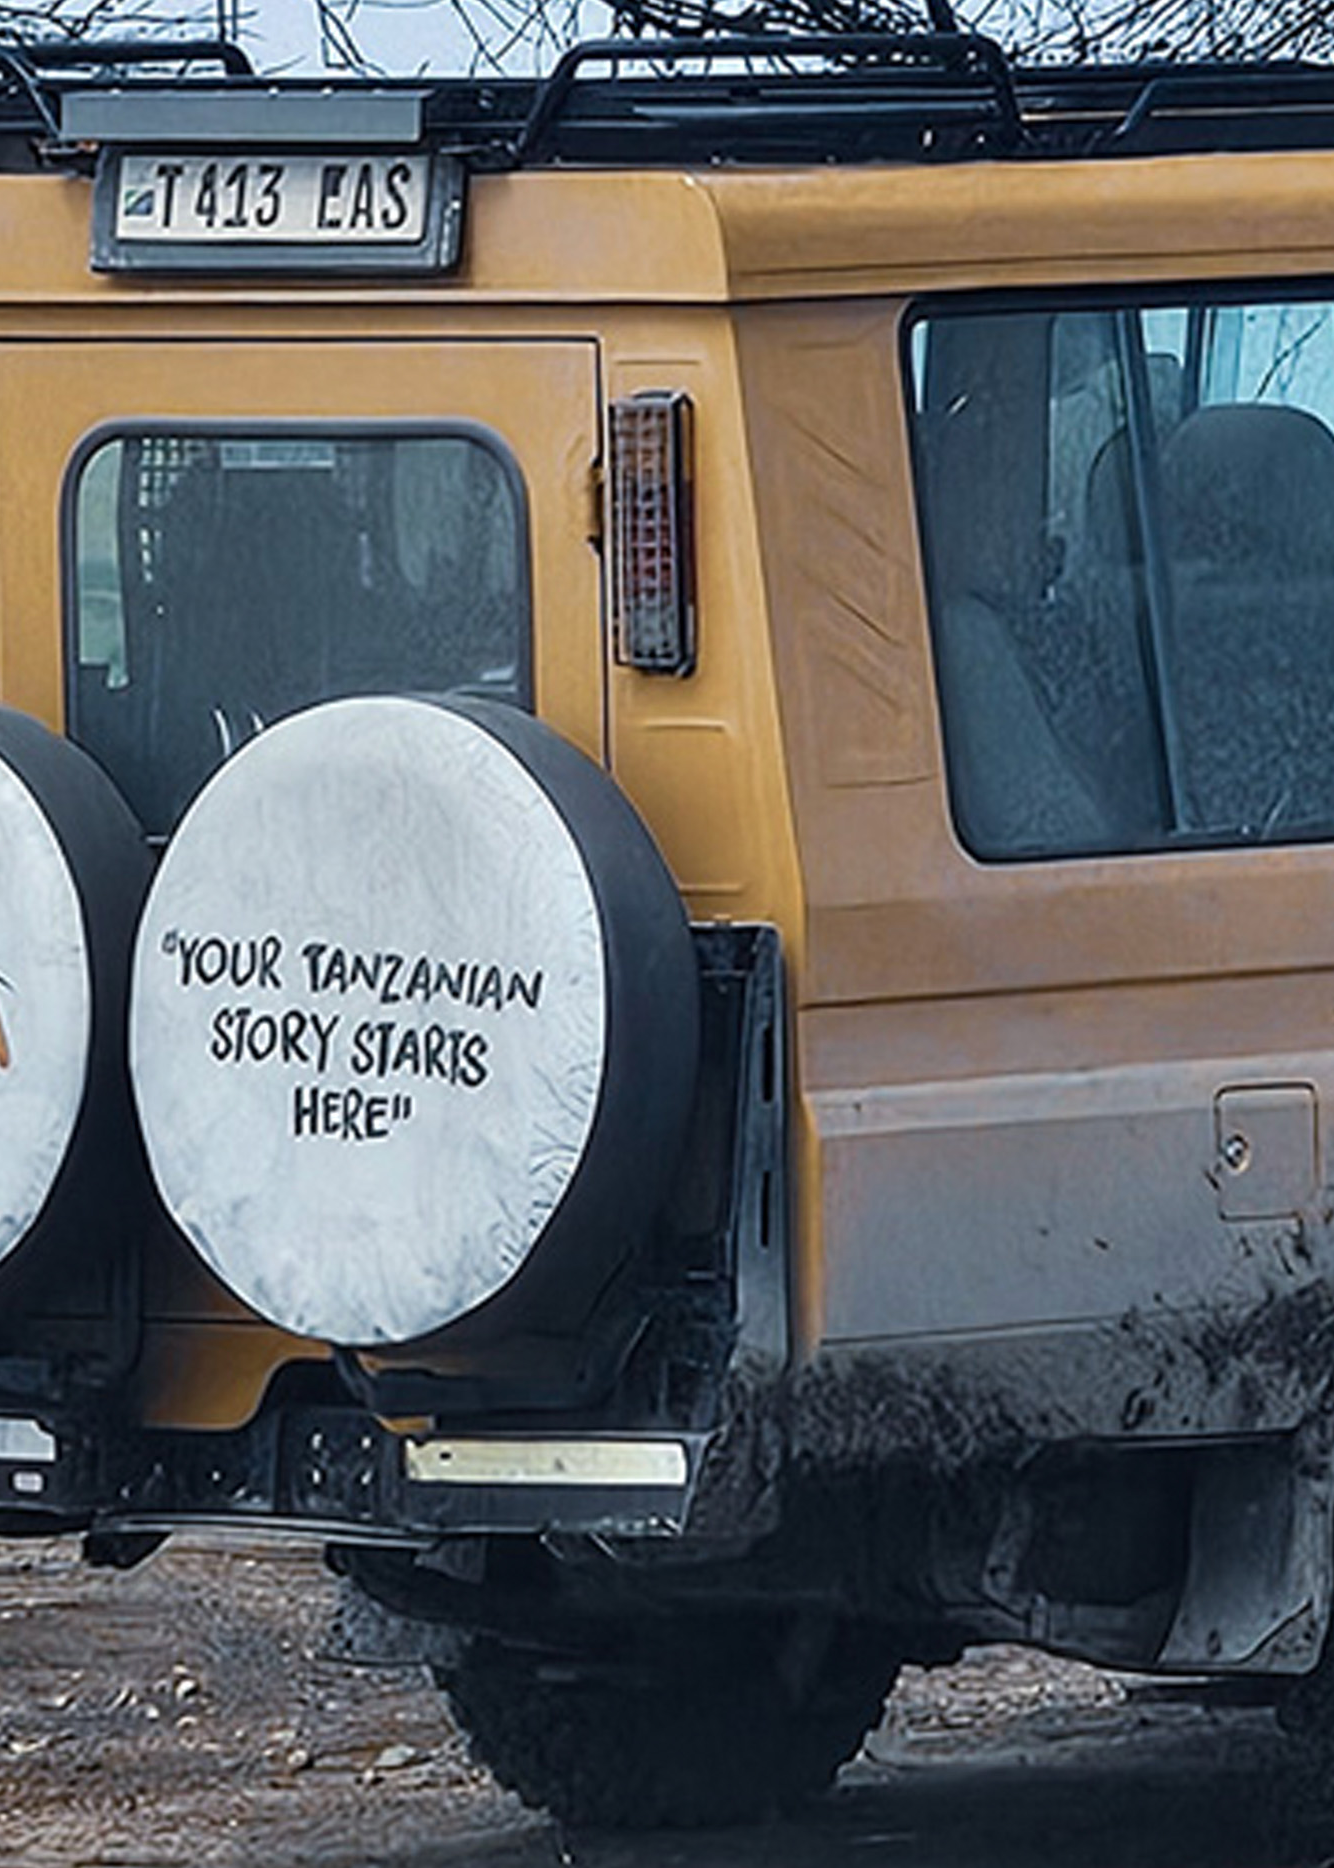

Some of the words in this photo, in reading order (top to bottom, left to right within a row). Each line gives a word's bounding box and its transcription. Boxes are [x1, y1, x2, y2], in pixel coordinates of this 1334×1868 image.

[157, 164, 183, 228] T
[195, 164, 284, 228] 413
[317, 164, 411, 229] EAS
[301, 942, 543, 1010] TANZANIAN
[211, 1008, 341, 1074] STORY
[350, 1020, 489, 1087] STARTS
[293, 1086, 412, 1141] HERE"
